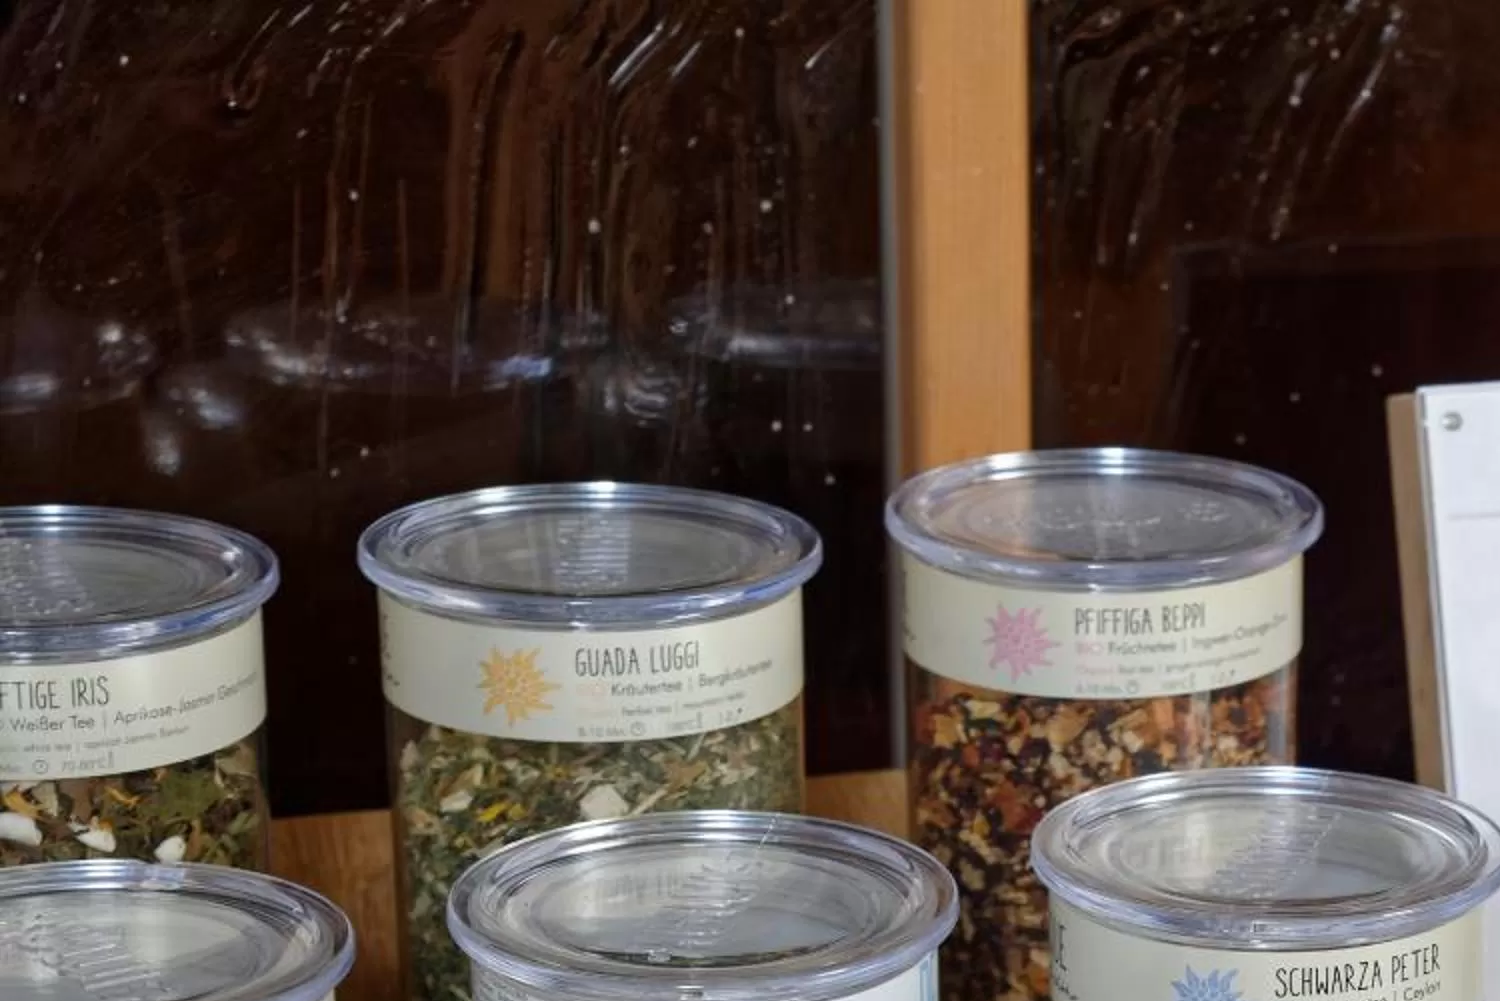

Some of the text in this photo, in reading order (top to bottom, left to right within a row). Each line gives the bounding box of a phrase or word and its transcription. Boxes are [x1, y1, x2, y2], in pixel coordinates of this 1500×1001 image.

[1074, 602, 1206, 636] PFIFFIGA BEPPI
[575, 640, 700, 677] GUADA LUGGI
[71, 675, 110, 708] IRIS
[10, 716, 65, 732] Weißer
[68, 714, 95, 729] Tee
[1274, 943, 1442, 998] SCHWARZA PETER
[1403, 979, 1442, 1001] Ceylon
